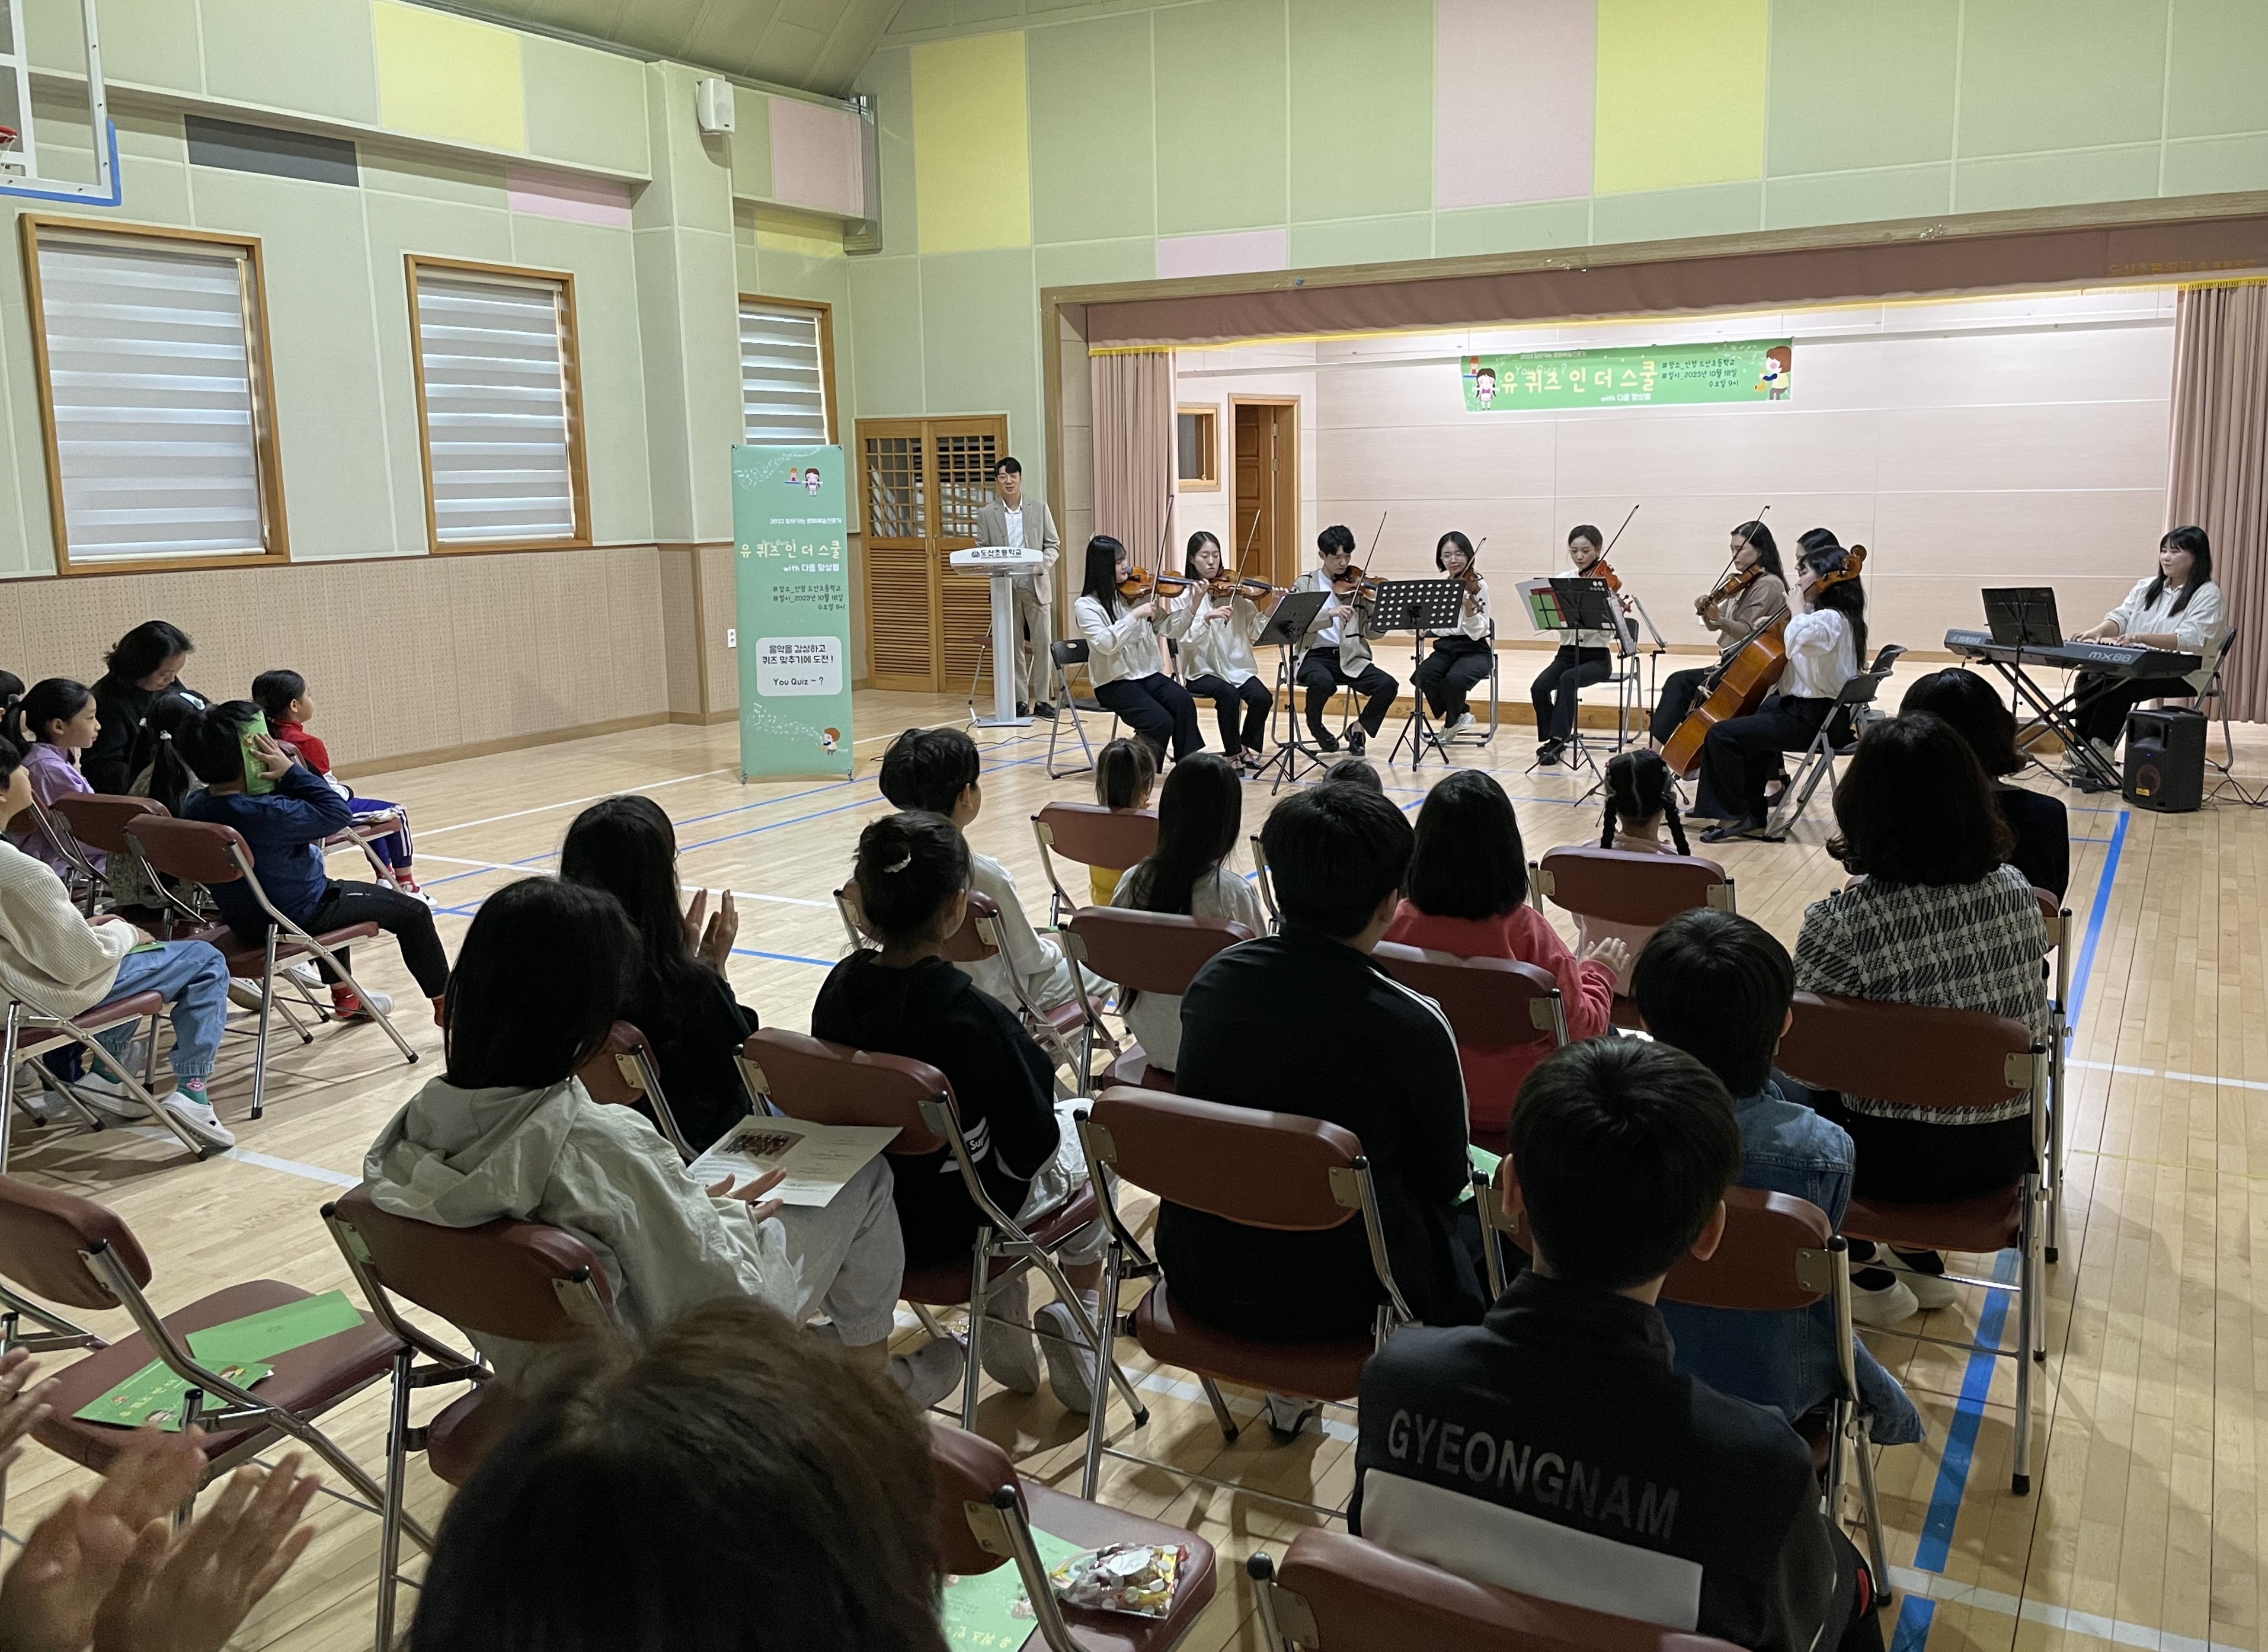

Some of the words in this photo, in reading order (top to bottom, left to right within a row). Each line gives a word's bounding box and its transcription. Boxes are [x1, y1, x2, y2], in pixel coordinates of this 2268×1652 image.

[1698, 358, 1735, 368] 도산초등학교
[1502, 371, 1518, 394] 유
[1525, 370, 1562, 393] 퀴즈
[1569, 367, 1586, 392] 인
[1594, 368, 1612, 389] 더
[1620, 360, 1658, 391] 스쿨
[1709, 368, 1722, 379] 10월
[1724, 368, 1737, 377] 18일
[1709, 379, 1726, 388] 수요일
[740, 543, 751, 558] 유
[756, 543, 780, 558] 퀴즈
[785, 542, 796, 558] 인
[801, 544, 813, 556] 더
[818, 540, 842, 559] 스쿨
[818, 593, 830, 603] 10월
[831, 594, 843, 602] 18일
[818, 603, 834, 612] 수요일
[769, 645, 792, 654] 음악을
[794, 645, 826, 653] 감상하고
[762, 656, 778, 664] 퀴즈
[779, 655, 811, 664] 맞추기에
[818, 677, 824, 686] ?
[1388, 1408, 1680, 1540] GYEONGNAM
